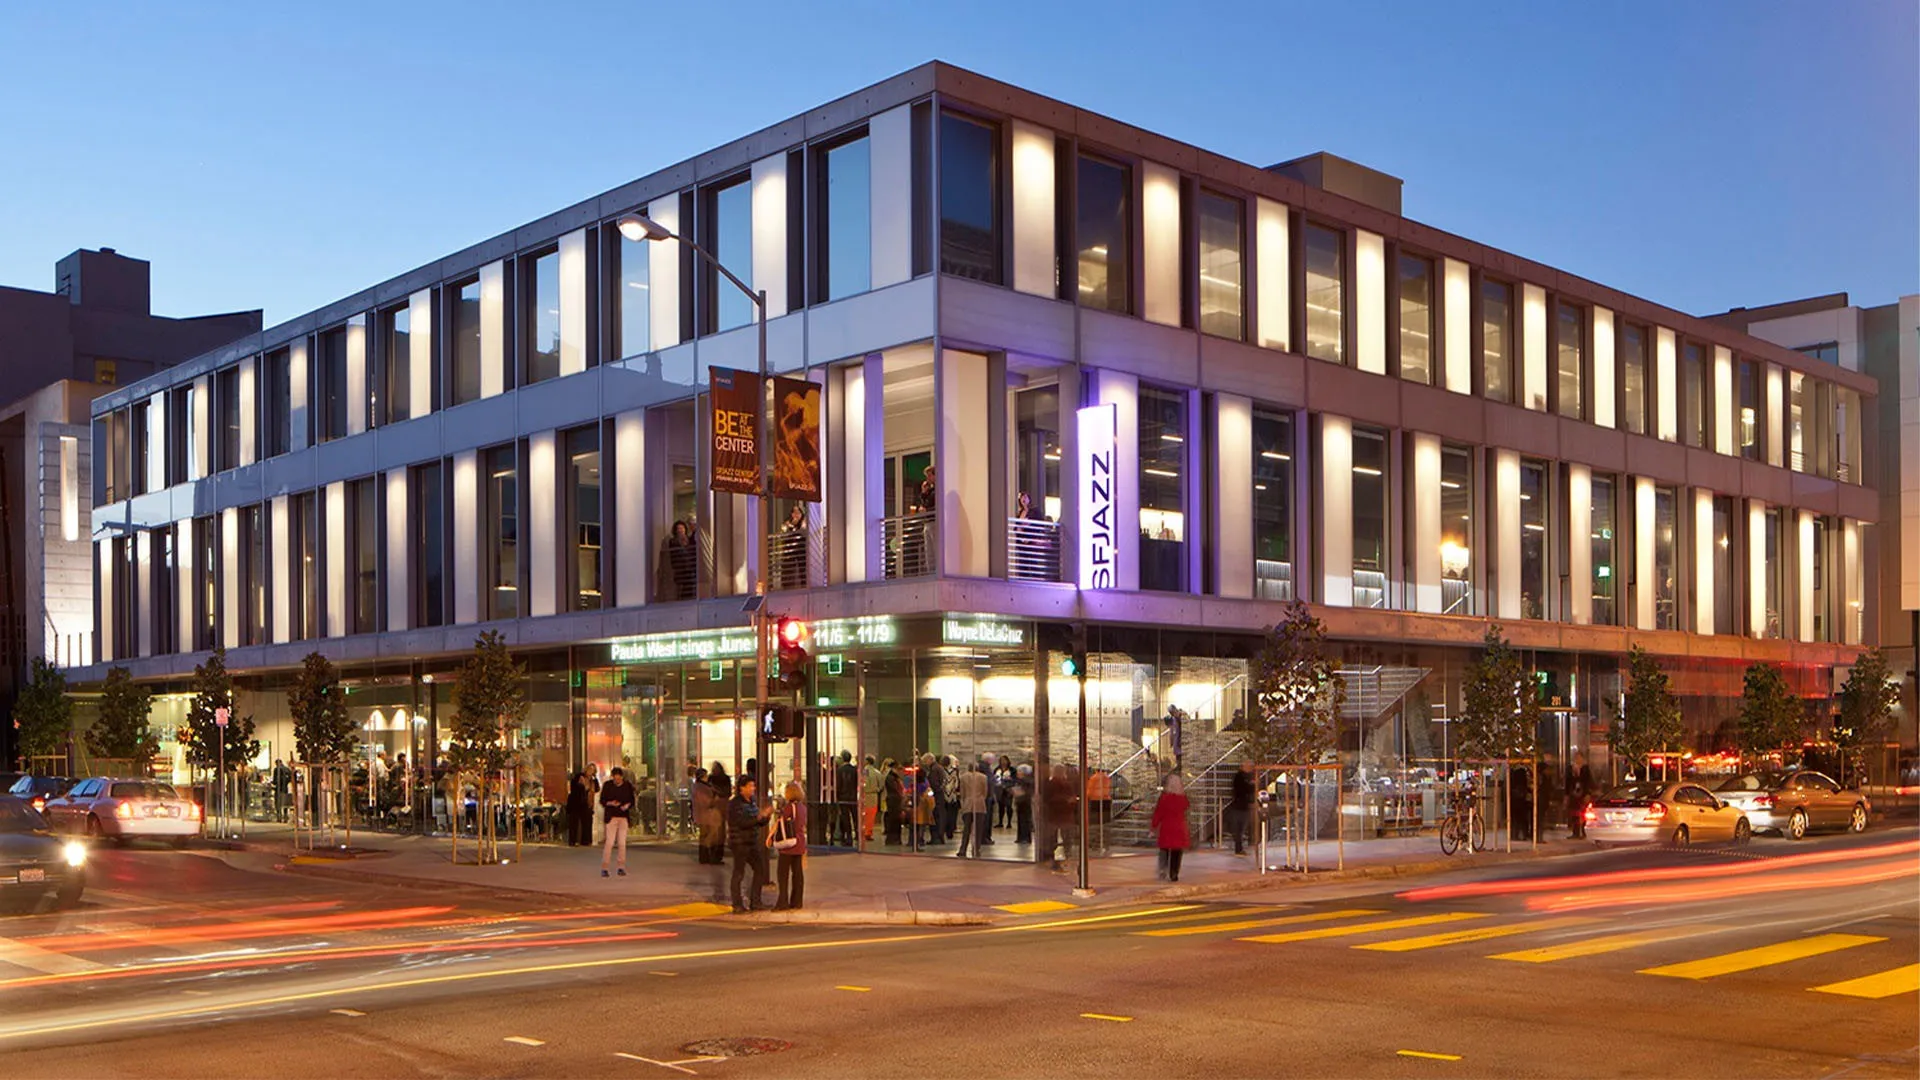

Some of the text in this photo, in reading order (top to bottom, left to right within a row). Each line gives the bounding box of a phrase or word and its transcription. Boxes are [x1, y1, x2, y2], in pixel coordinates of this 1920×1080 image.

[715, 409, 739, 436] BE
[715, 435, 755, 455] CENTER
[1092, 450, 1110, 589] SFJAZZ
[611, 643, 643, 661] Paula
[647, 640, 676, 658] West
[680, 639, 713, 659] sings
[717, 635, 751, 653] June
[813, 627, 844, 647] 11/6
[857, 623, 890, 644] 11/9
[947, 620, 978, 644] Wayne
